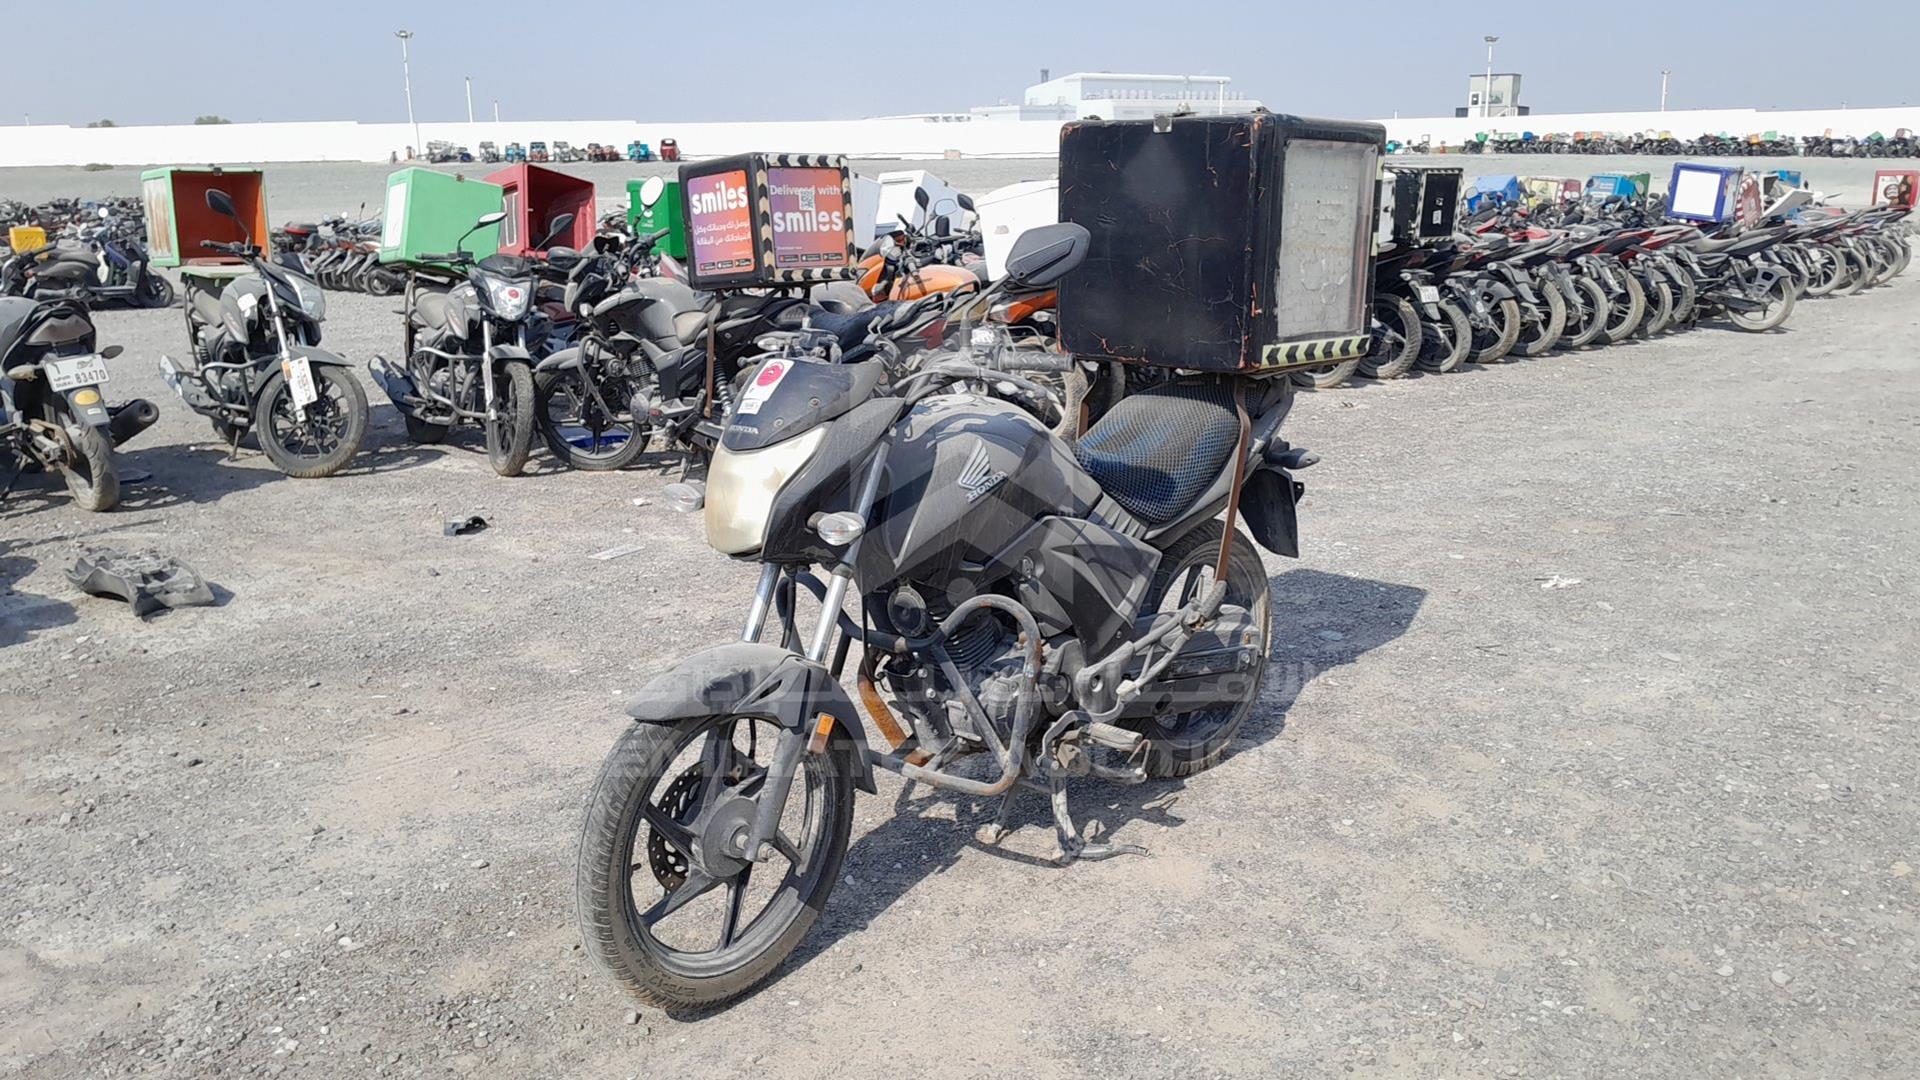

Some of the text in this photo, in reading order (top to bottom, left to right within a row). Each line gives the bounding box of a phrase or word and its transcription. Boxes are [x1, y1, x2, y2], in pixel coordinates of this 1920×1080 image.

[692, 180, 748, 215] smiles
[818, 185, 841, 196] with
[773, 210, 844, 233] smiles
[728, 424, 760, 436] HONDA
[965, 471, 1008, 503] HONDA
